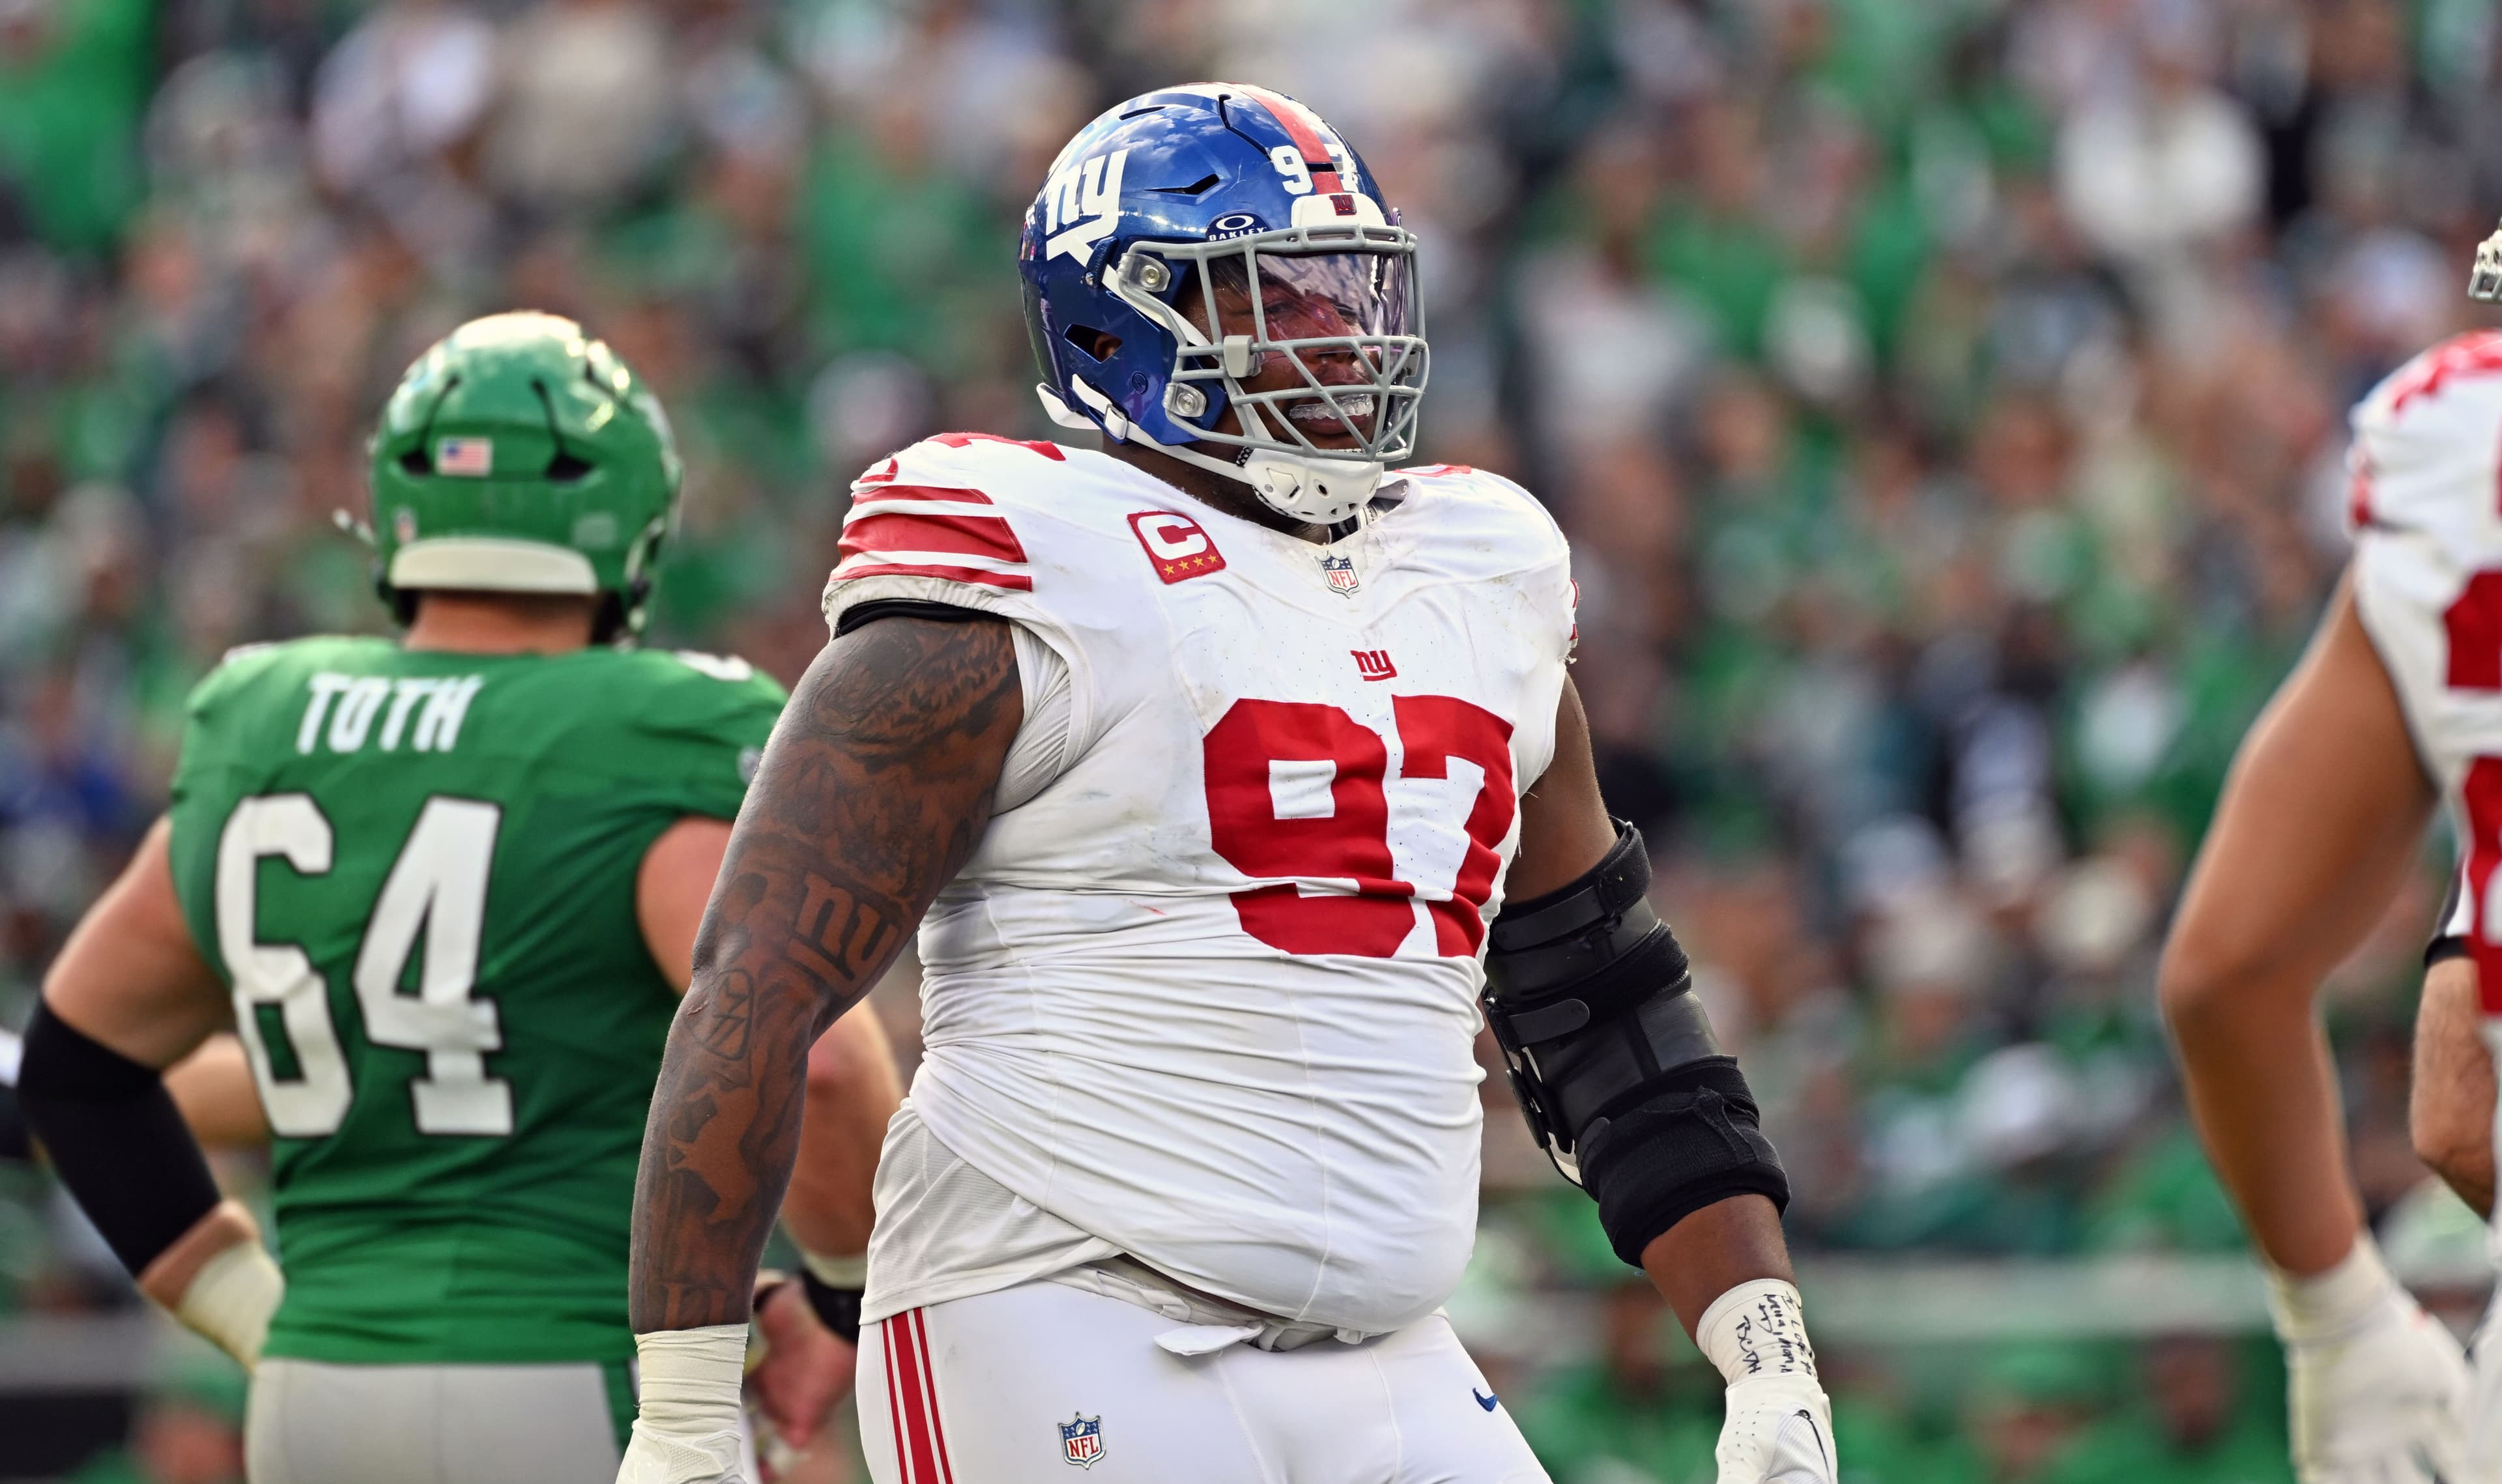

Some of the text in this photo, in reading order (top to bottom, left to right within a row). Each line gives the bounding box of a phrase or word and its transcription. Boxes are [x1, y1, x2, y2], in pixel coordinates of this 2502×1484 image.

[1209, 227, 1265, 242] OAKLEY
[1137, 514, 1208, 561] C
[1329, 570, 1356, 589] NFL
[296, 671, 485, 755] TOTH
[1203, 694, 1516, 959] 97
[214, 792, 515, 1138] 64
[1067, 1436, 1099, 1459] NFL
